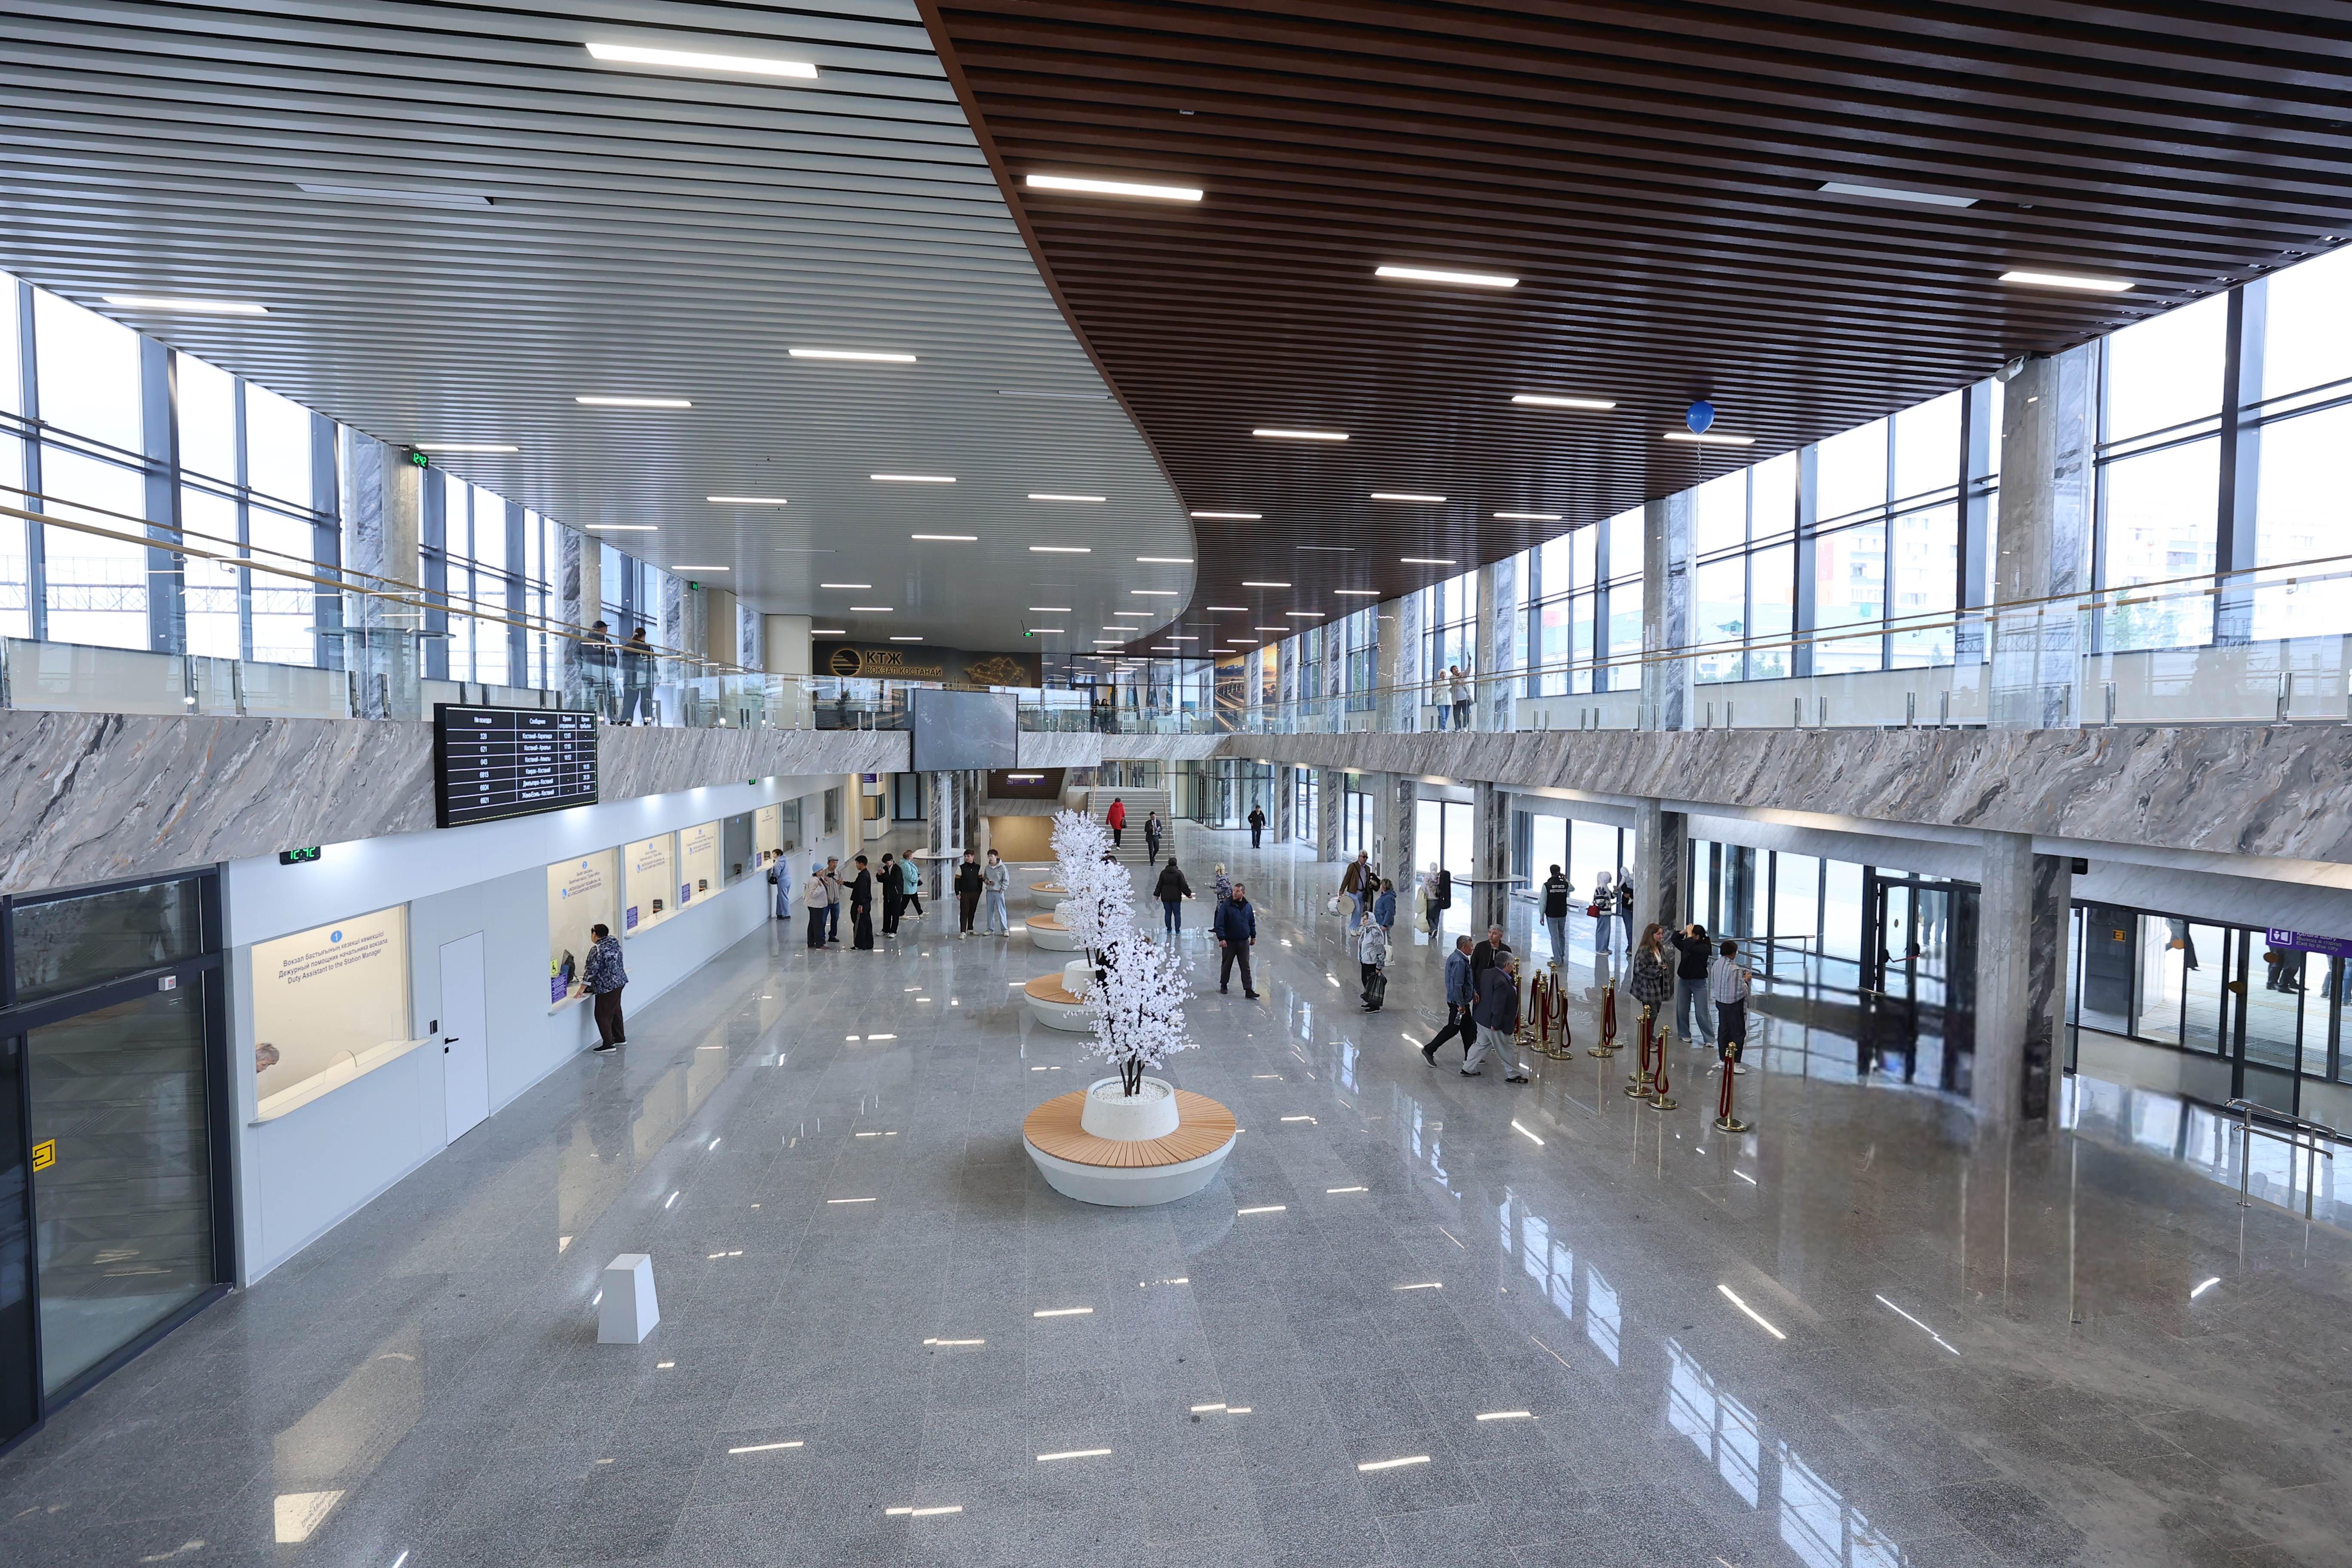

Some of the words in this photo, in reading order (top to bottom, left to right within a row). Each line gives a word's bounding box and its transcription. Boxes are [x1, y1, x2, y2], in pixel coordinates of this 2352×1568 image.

[413, 453, 426, 467] 12:42
[866, 652, 901, 665] КТЖ
[866, 666, 897, 674] ВОКЗАЛ
[899, 667, 941, 676] КОСТАНАЙ
[334, 932, 338, 941] 1
[2296, 936, 2317, 944] Выход
[283, 956, 304, 967] Вокзал
[305, 945, 340, 960] бастығының
[341, 938, 360, 949] кезекші
[361, 931, 384, 943] көмекшісі
[279, 962, 309, 979] Дежурный
[311, 954, 339, 968] помощник
[340, 945, 369, 958] начальника
[370, 939, 388, 949] вокзала
[288, 975, 301, 984] Duty
[302, 966, 328, 980] Assistant
[344, 955, 361, 965] Station
[362, 948, 382, 959] Manager
